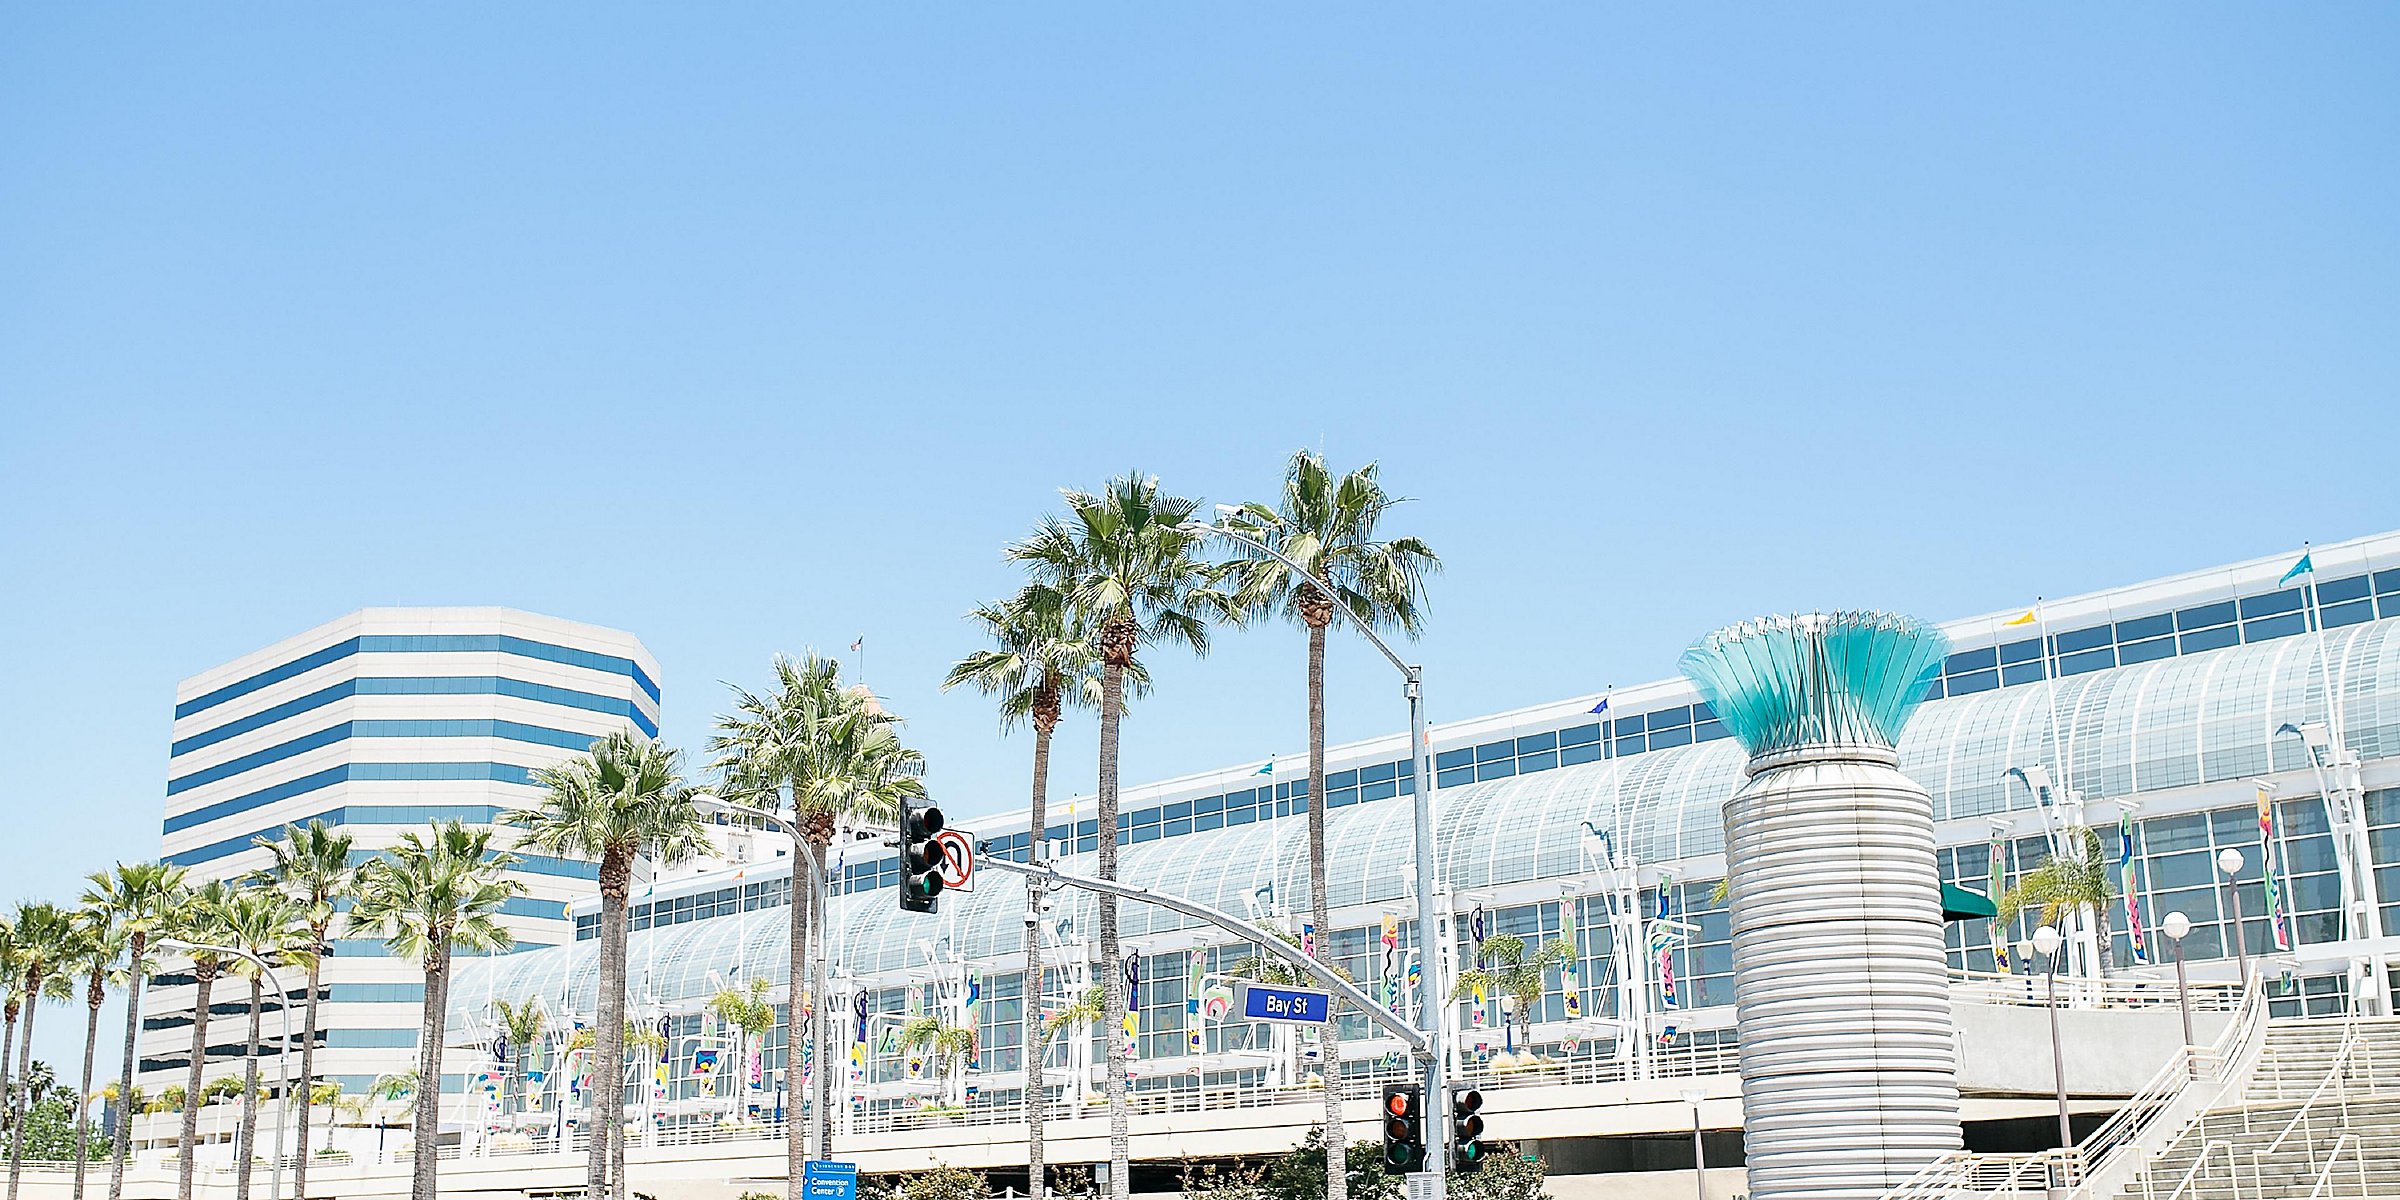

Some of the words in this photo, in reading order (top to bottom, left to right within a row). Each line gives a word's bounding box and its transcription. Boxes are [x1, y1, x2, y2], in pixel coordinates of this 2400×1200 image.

[1266, 994, 1291, 1017] Bay
[1293, 997, 1308, 1015] St
[811, 1177, 849, 1186] Convention
[811, 1186, 835, 1195] Center
